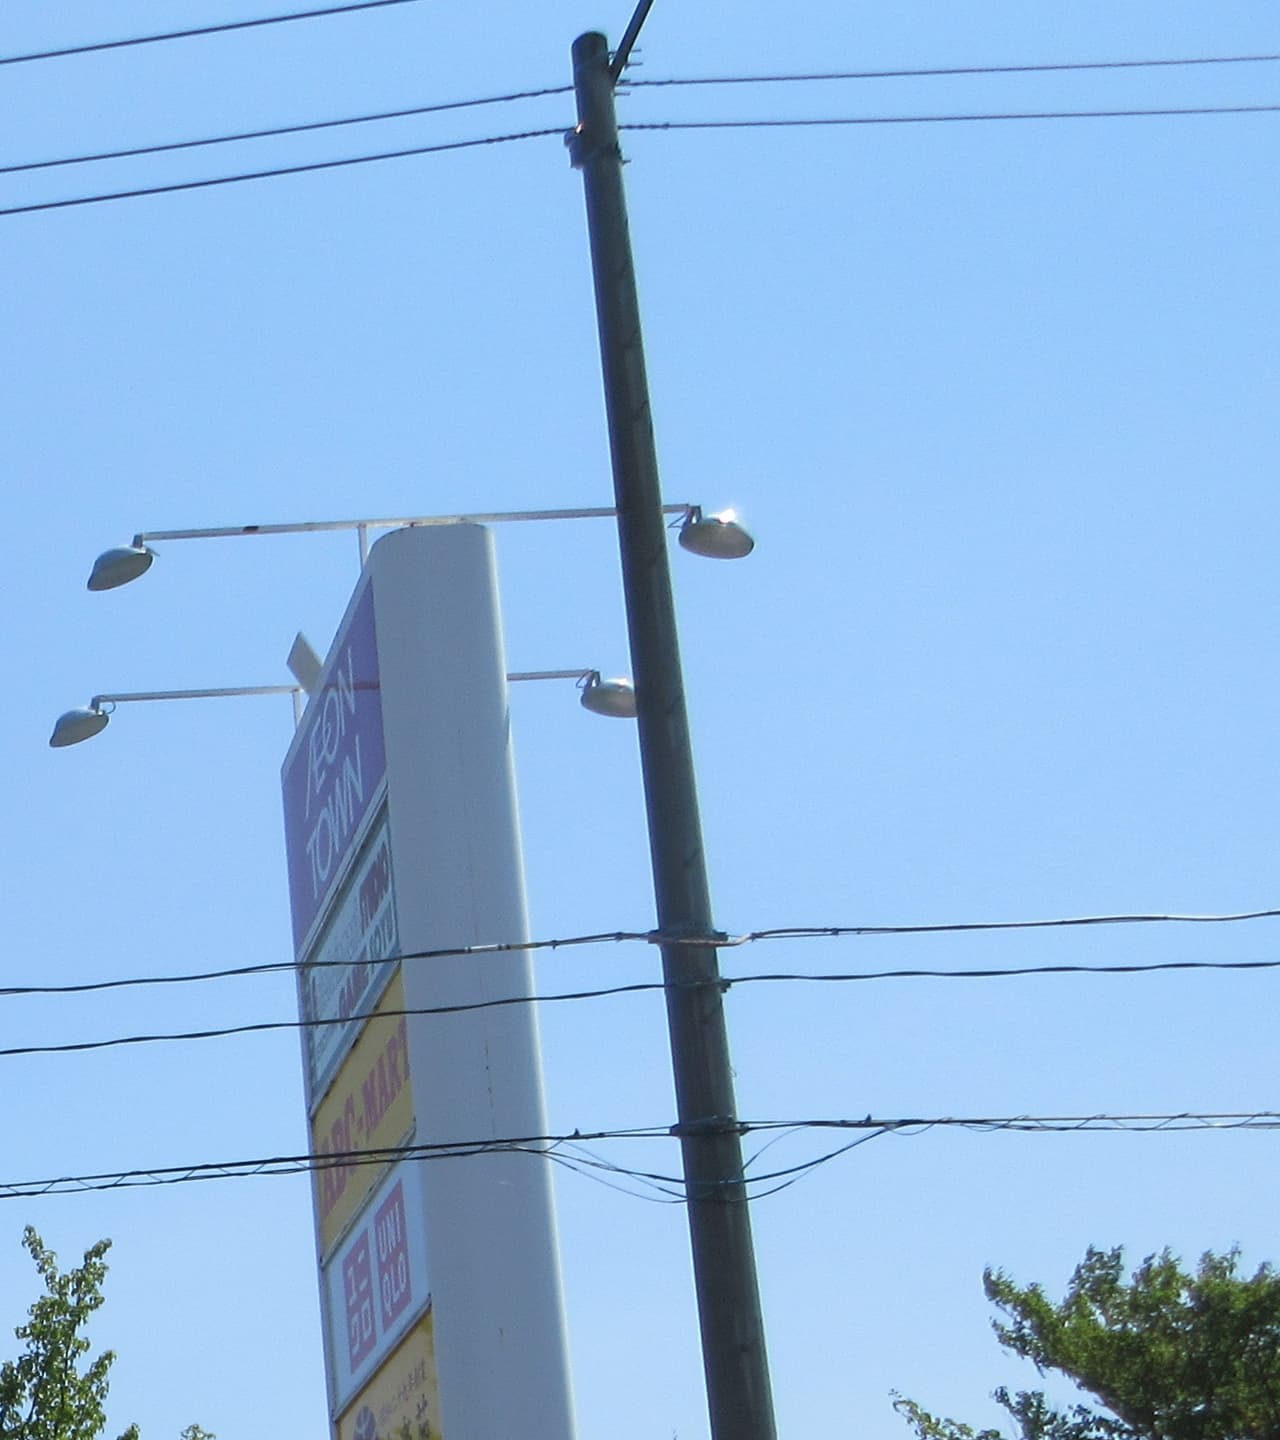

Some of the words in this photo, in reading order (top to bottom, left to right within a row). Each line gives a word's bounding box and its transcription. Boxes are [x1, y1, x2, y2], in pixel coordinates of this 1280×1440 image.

[306, 733, 364, 900] TOWN
[378, 1201, 403, 1263] UNI
[383, 1262, 409, 1318] QLO
